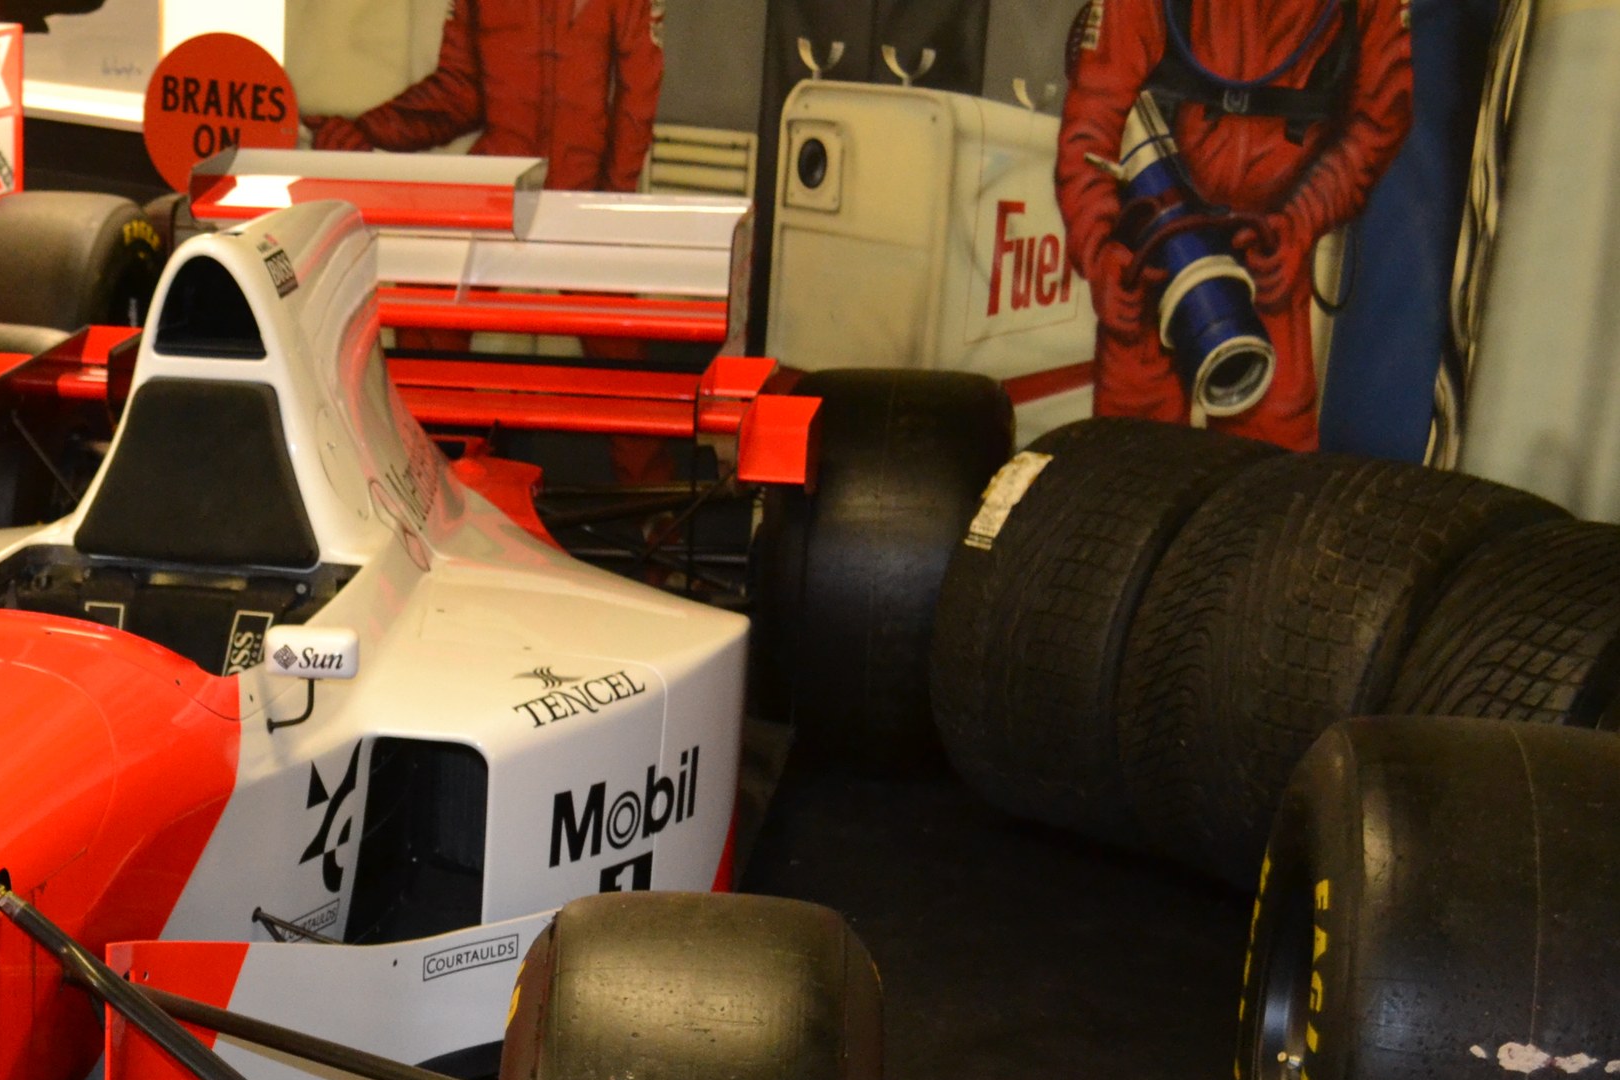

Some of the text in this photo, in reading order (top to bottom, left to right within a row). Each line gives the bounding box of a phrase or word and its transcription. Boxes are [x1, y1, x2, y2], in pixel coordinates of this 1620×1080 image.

[161, 75, 287, 123] BRAKES
[193, 124, 240, 159] ON
[986, 200, 1073, 317] Fuel
[298, 647, 343, 670] Sun
[512, 670, 646, 728] TENCEL
[549, 745, 700, 868] Mobil
[426, 941, 515, 975] COURTAULDS
